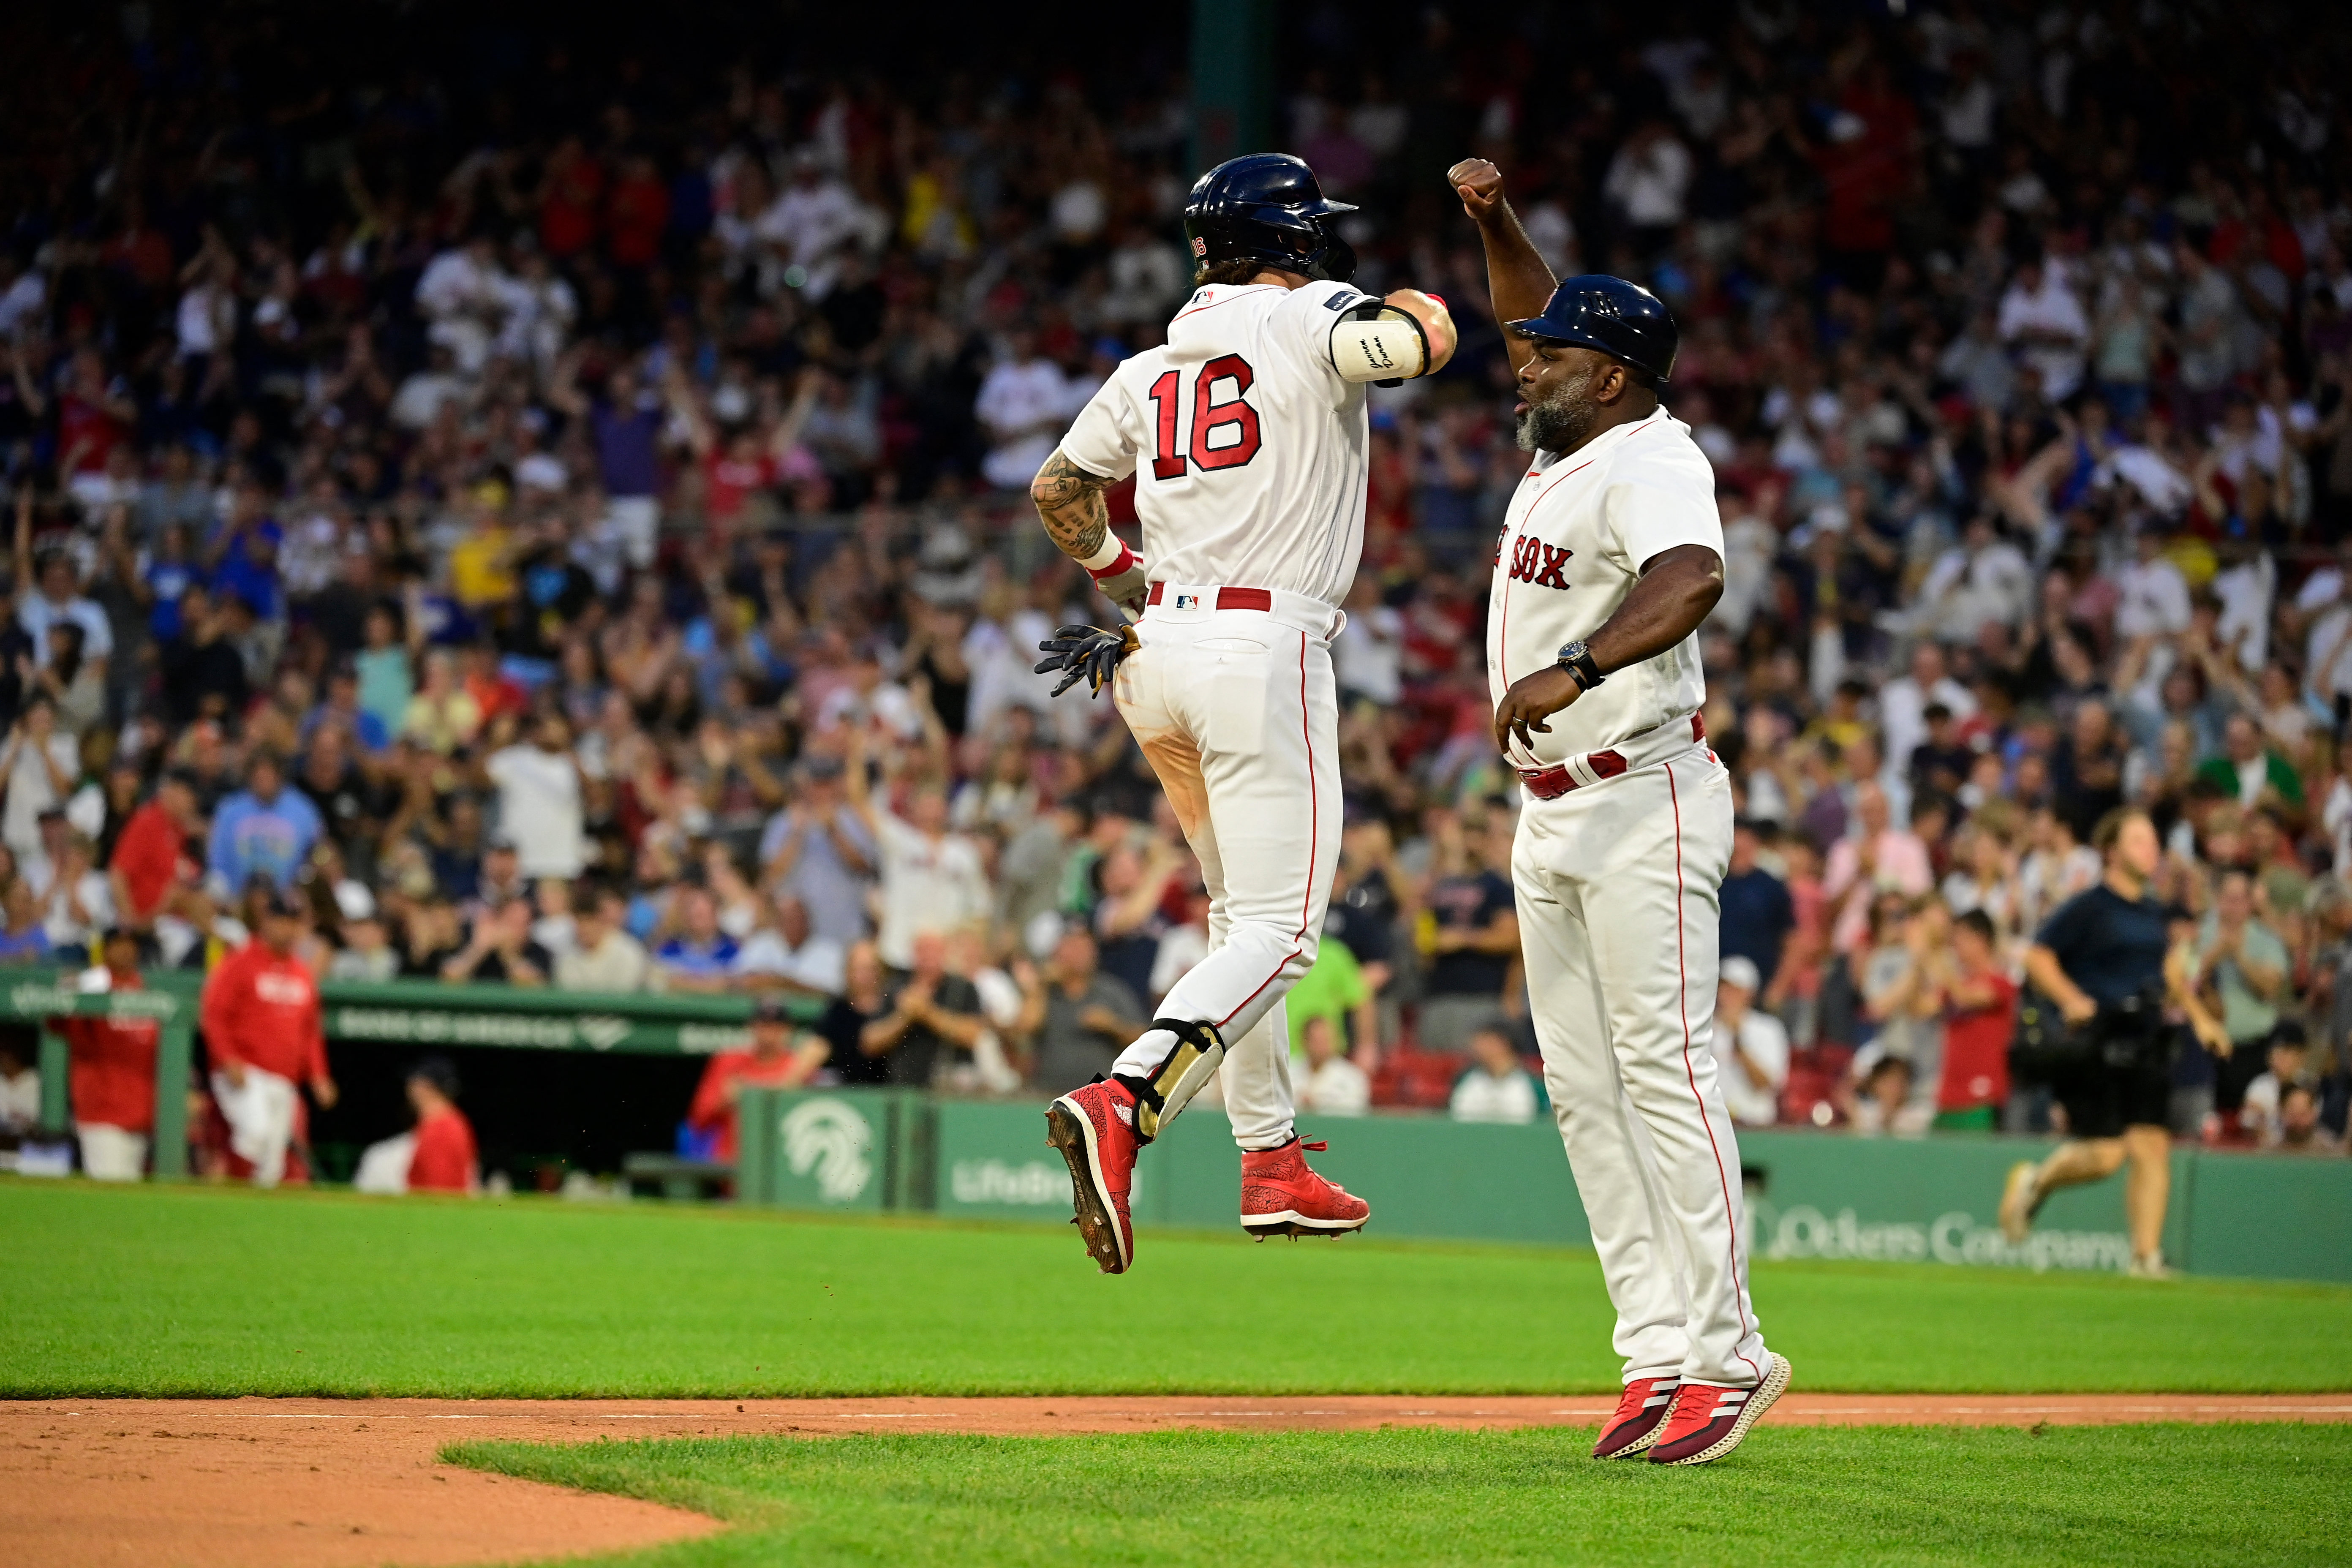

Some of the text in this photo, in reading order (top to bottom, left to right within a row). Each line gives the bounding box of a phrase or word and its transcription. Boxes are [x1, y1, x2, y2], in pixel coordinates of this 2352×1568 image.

[1192, 237, 1207, 258] 16
[1359, 338, 1383, 368] Jarren
[1373, 335, 1394, 368] Duran
[1149, 353, 1262, 481] 16
[1509, 534, 1574, 591] SOX
